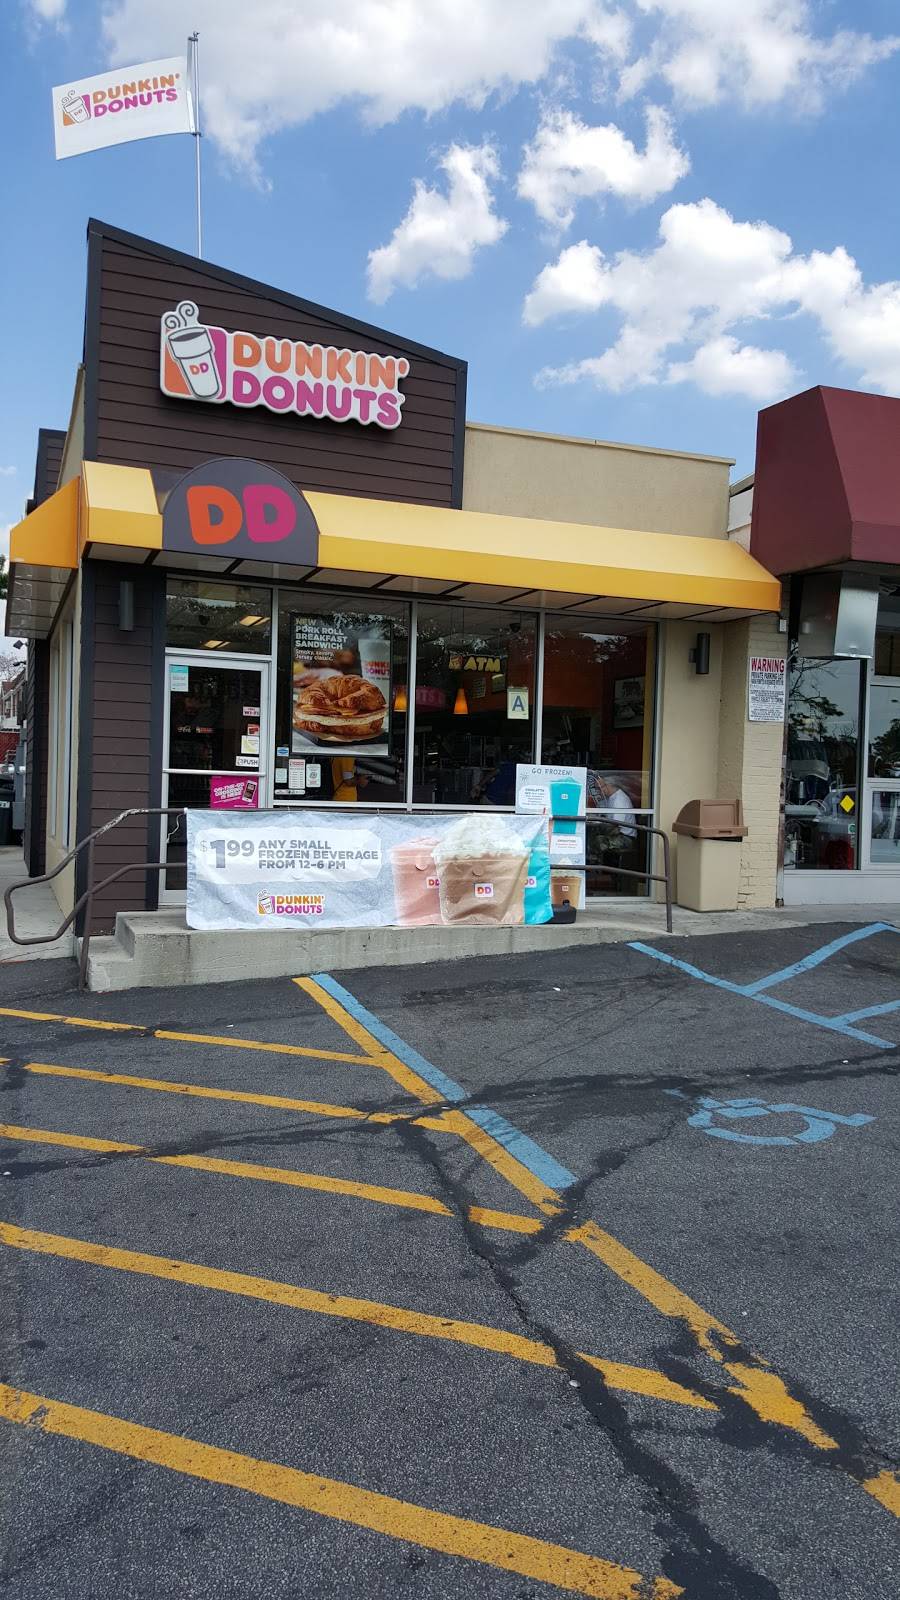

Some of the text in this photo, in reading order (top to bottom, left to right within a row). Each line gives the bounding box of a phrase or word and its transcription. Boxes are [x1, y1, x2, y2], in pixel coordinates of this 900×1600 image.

[93, 73, 180, 104] DUNKIN'
[94, 88, 178, 117] DONUTS
[233, 334, 408, 389] DUNKIN'
[189, 362, 209, 375] DD
[232, 370, 399, 425] DONUTS
[186, 484, 297, 544] DD
[295, 625, 345, 636] PORK ROLL
[295, 633, 348, 643] BREAKFAST
[295, 640, 343, 650] SANDWICH
[464, 656, 501, 673] ATM
[751, 658, 785, 673] WARNING
[512, 695, 525, 712] A
[531, 767, 573, 777] GO FROZEN!
[258, 840, 331, 850] ANY SMALL
[258, 850, 378, 860] FROZEN BEVERAGE
[258, 860, 346, 870] FROM 12-6 PM
[476, 886, 492, 895] DD
[276, 895, 324, 905] DUNKIN'
[276, 905, 322, 914] DONUTS
